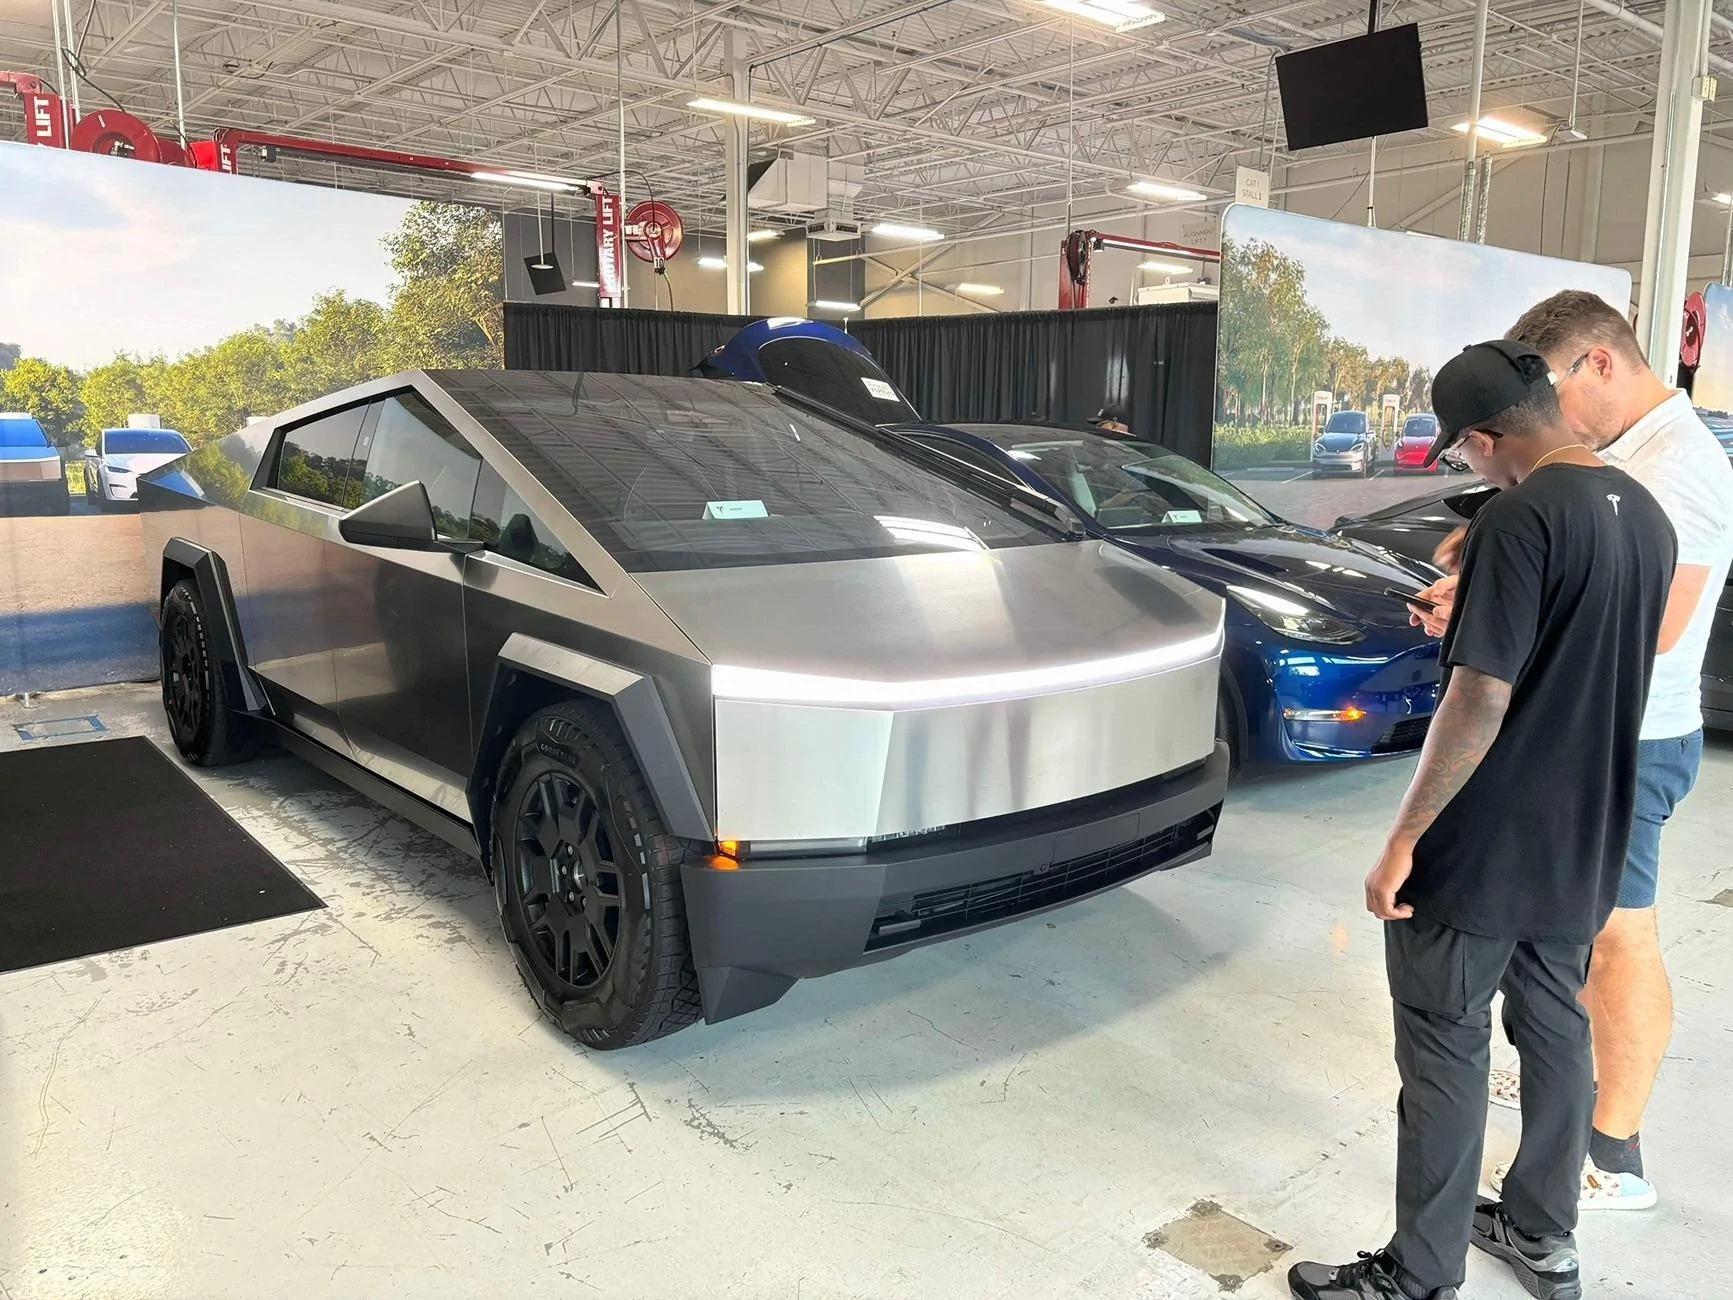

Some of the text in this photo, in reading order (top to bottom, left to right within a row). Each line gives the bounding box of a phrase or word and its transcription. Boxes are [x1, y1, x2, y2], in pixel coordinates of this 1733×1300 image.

[34, 96, 52, 137] LIFT
[221, 144, 232, 175] IFT
[602, 196, 614, 225] LIFT
